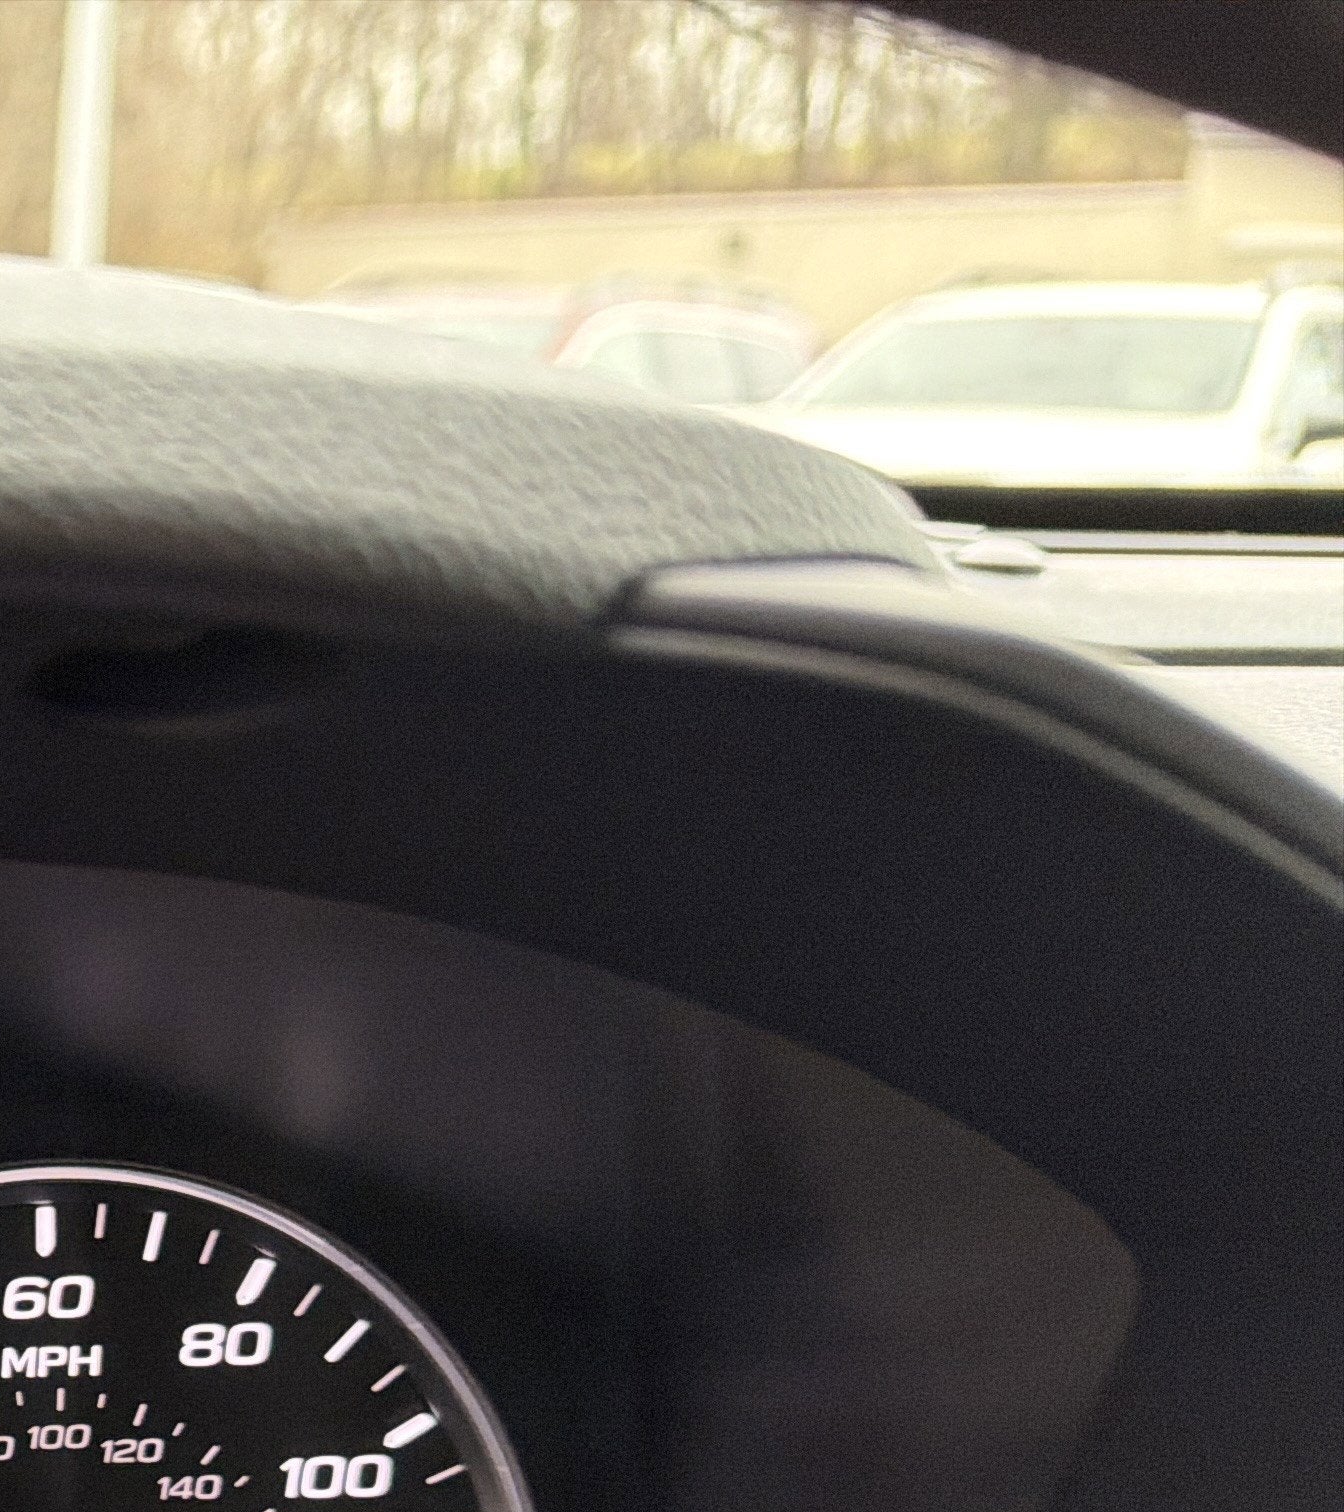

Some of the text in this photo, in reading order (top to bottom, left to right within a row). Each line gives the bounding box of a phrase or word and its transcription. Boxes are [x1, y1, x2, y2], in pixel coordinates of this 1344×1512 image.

[1, 1273, 96, 1321] 60
[0, 1343, 105, 1380] MPH
[177, 1320, 274, 1368] 80
[25, 1422, 93, 1451] 100
[99, 1436, 166, 1465] 120
[156, 1473, 224, 1502] 140
[277, 1452, 395, 1501] 100
